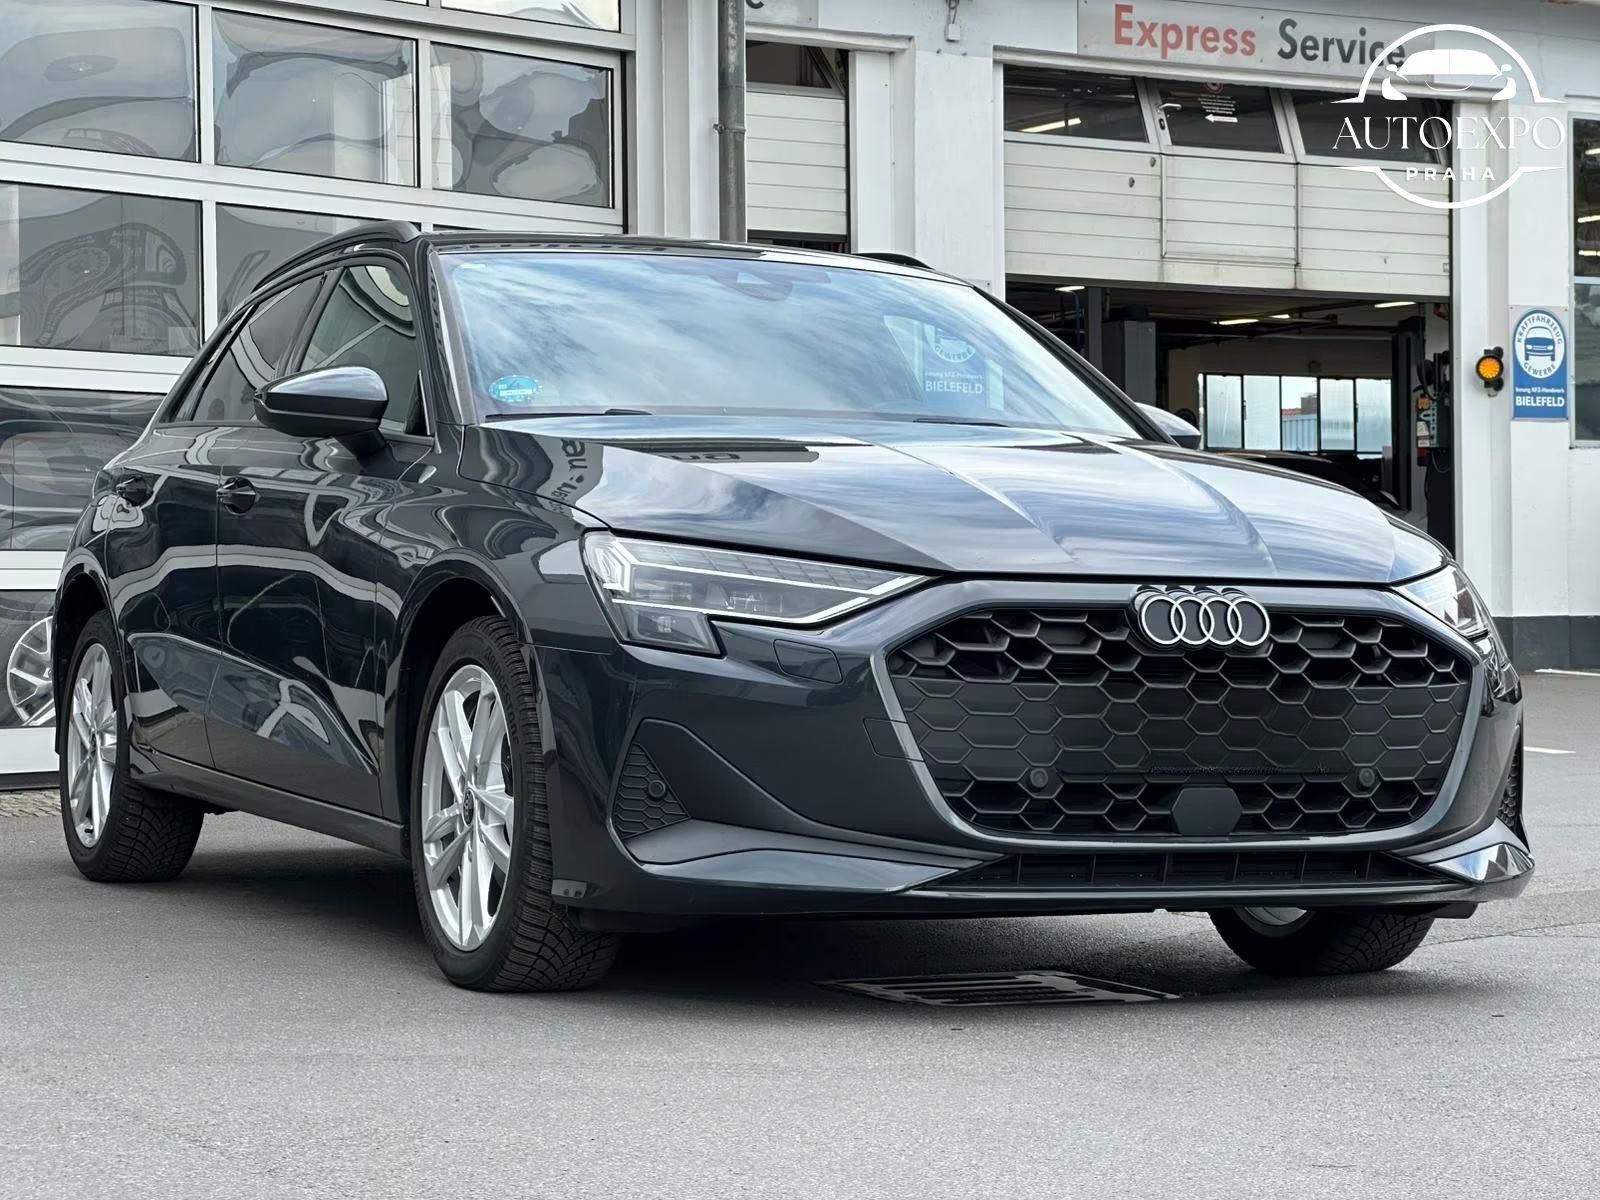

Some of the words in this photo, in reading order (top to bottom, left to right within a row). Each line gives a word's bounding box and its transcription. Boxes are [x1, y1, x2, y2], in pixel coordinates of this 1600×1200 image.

[1114, 4, 1256, 60] Express
[1277, 18, 1406, 68] Service
[1516, 315, 1563, 345] KRAFTFAHRZEUG
[1523, 361, 1557, 377] GEWERBE
[925, 380, 983, 394] BIELEFELD
[1515, 396, 1565, 407] BIELEFELD
